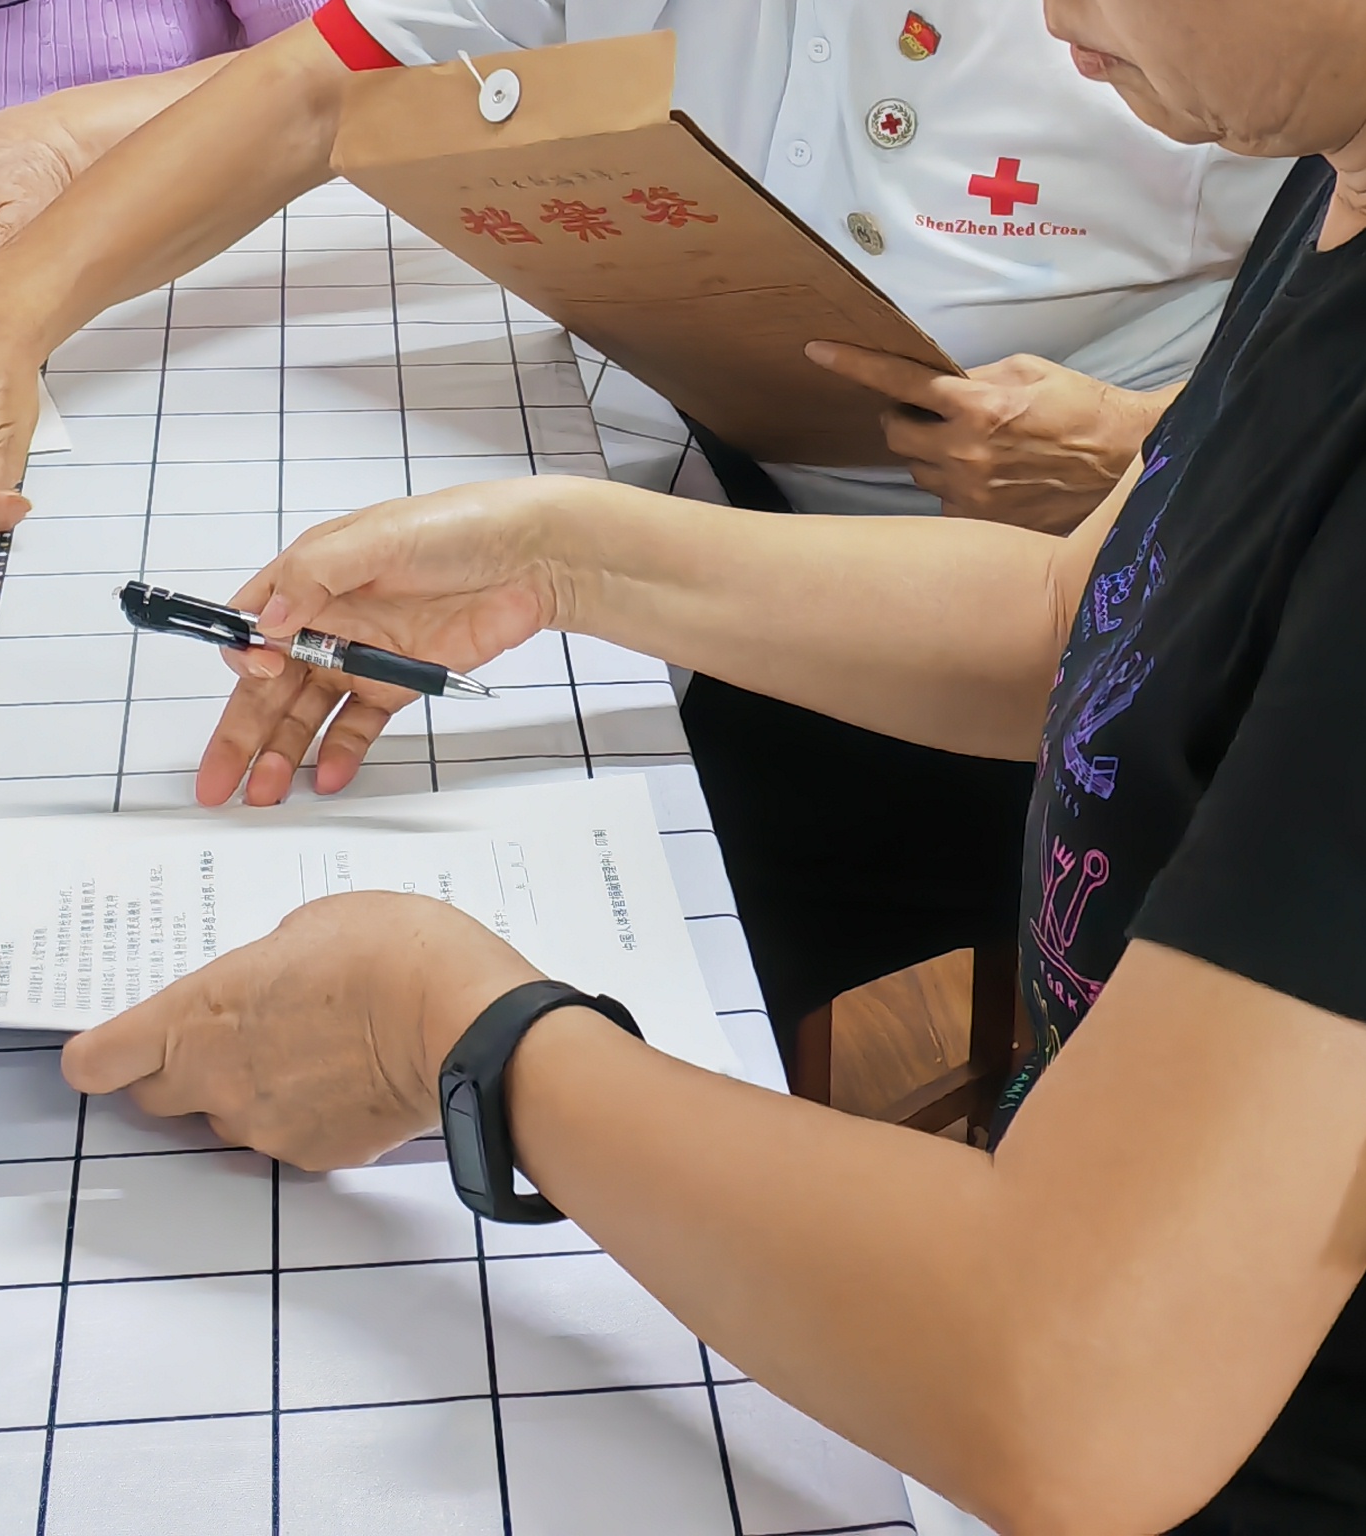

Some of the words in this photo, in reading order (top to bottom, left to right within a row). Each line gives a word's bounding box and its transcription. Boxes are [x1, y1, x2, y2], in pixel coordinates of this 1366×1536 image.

[915, 214, 997, 236] ShenZhen
[1002, 222, 1035, 236] Red
[1039, 221, 1088, 236] Cross
